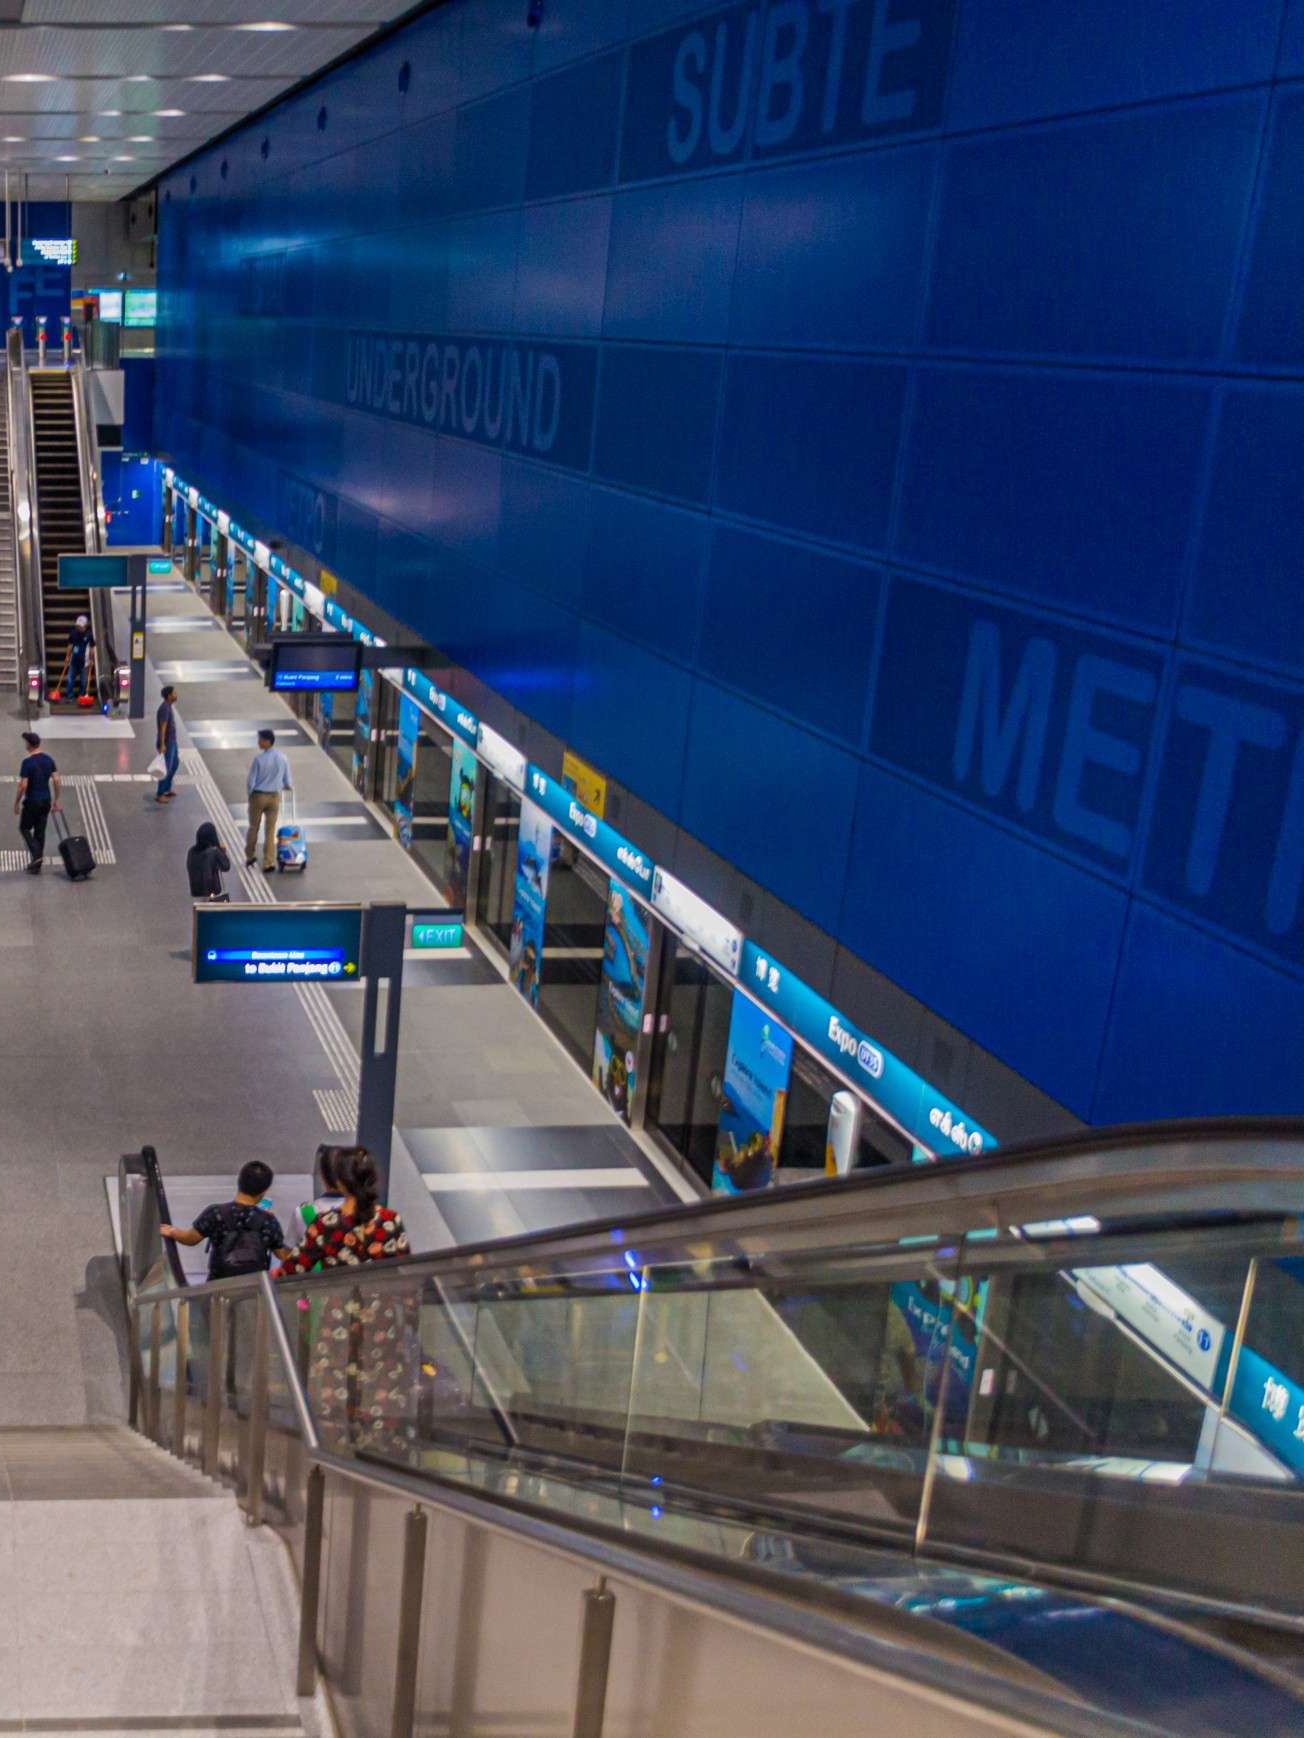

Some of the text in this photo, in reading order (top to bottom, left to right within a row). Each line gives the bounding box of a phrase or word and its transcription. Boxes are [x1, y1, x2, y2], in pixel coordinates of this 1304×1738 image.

[666, 0, 918, 165] SUBTE
[345, 330, 562, 454] UNDERGROUND
[425, 927, 456, 943] EXIT
[244, 963, 257, 974] to
[257, 961, 285, 974] Bukit
[286, 962, 328, 975] Panjang
[828, 1015, 858, 1057] Expo
